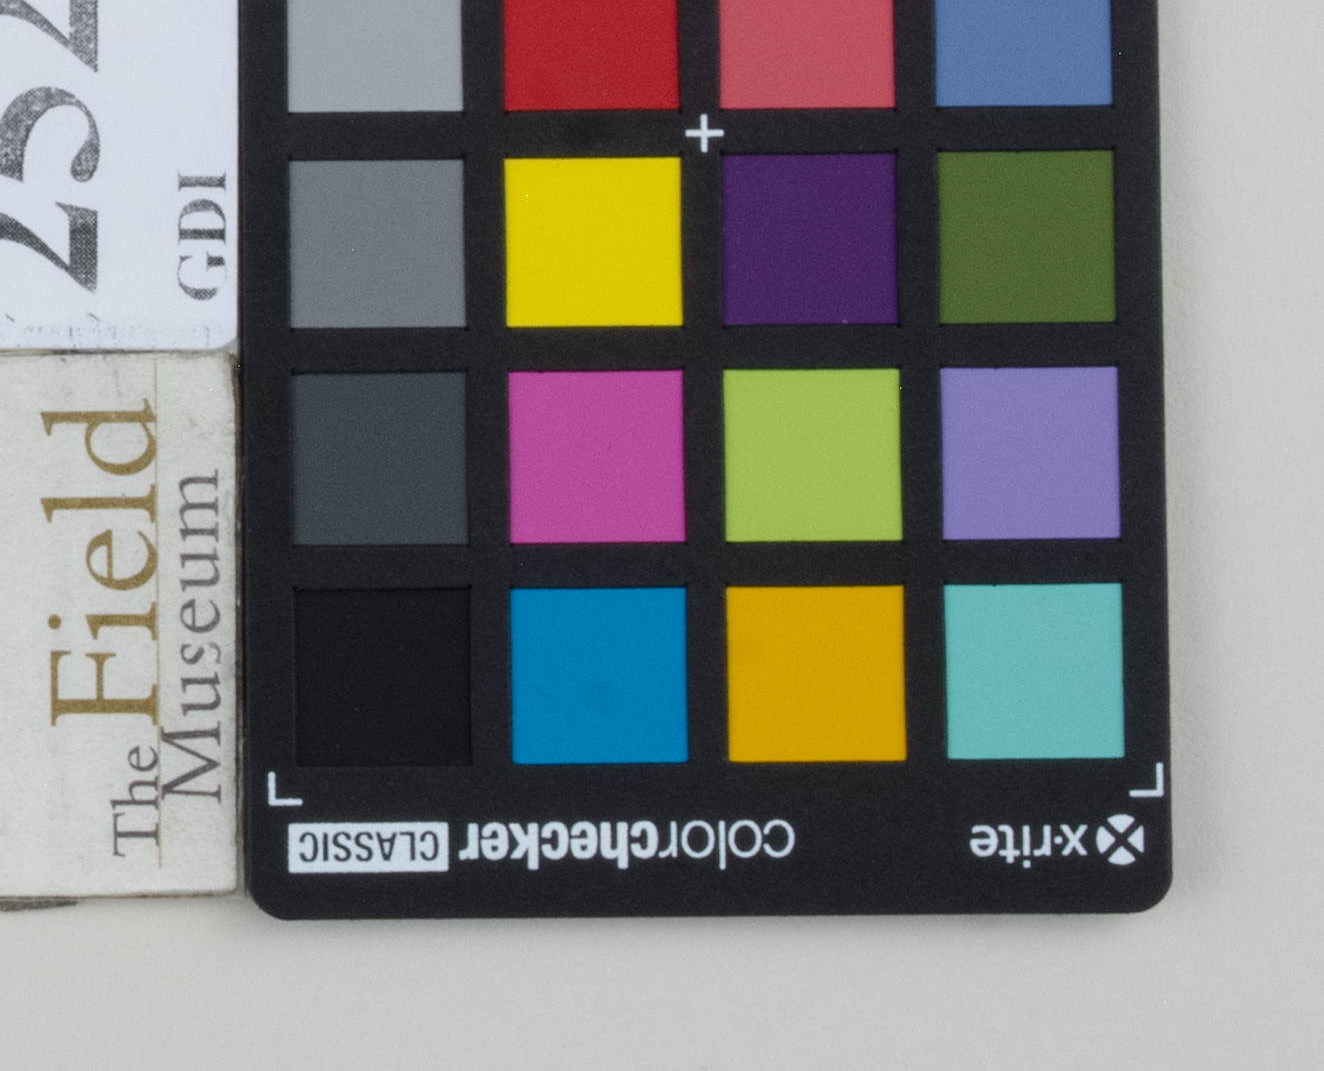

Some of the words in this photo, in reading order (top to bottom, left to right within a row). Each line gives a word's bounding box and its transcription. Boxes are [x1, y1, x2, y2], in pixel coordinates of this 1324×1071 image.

[176, 171, 227, 301] GDI
[40, 398, 158, 726] Field
[161, 468, 222, 804] Museum
[110, 745, 159, 857] The
[299, 829, 439, 863] CLASSIC
[458, 820, 795, 870] colorchecker
